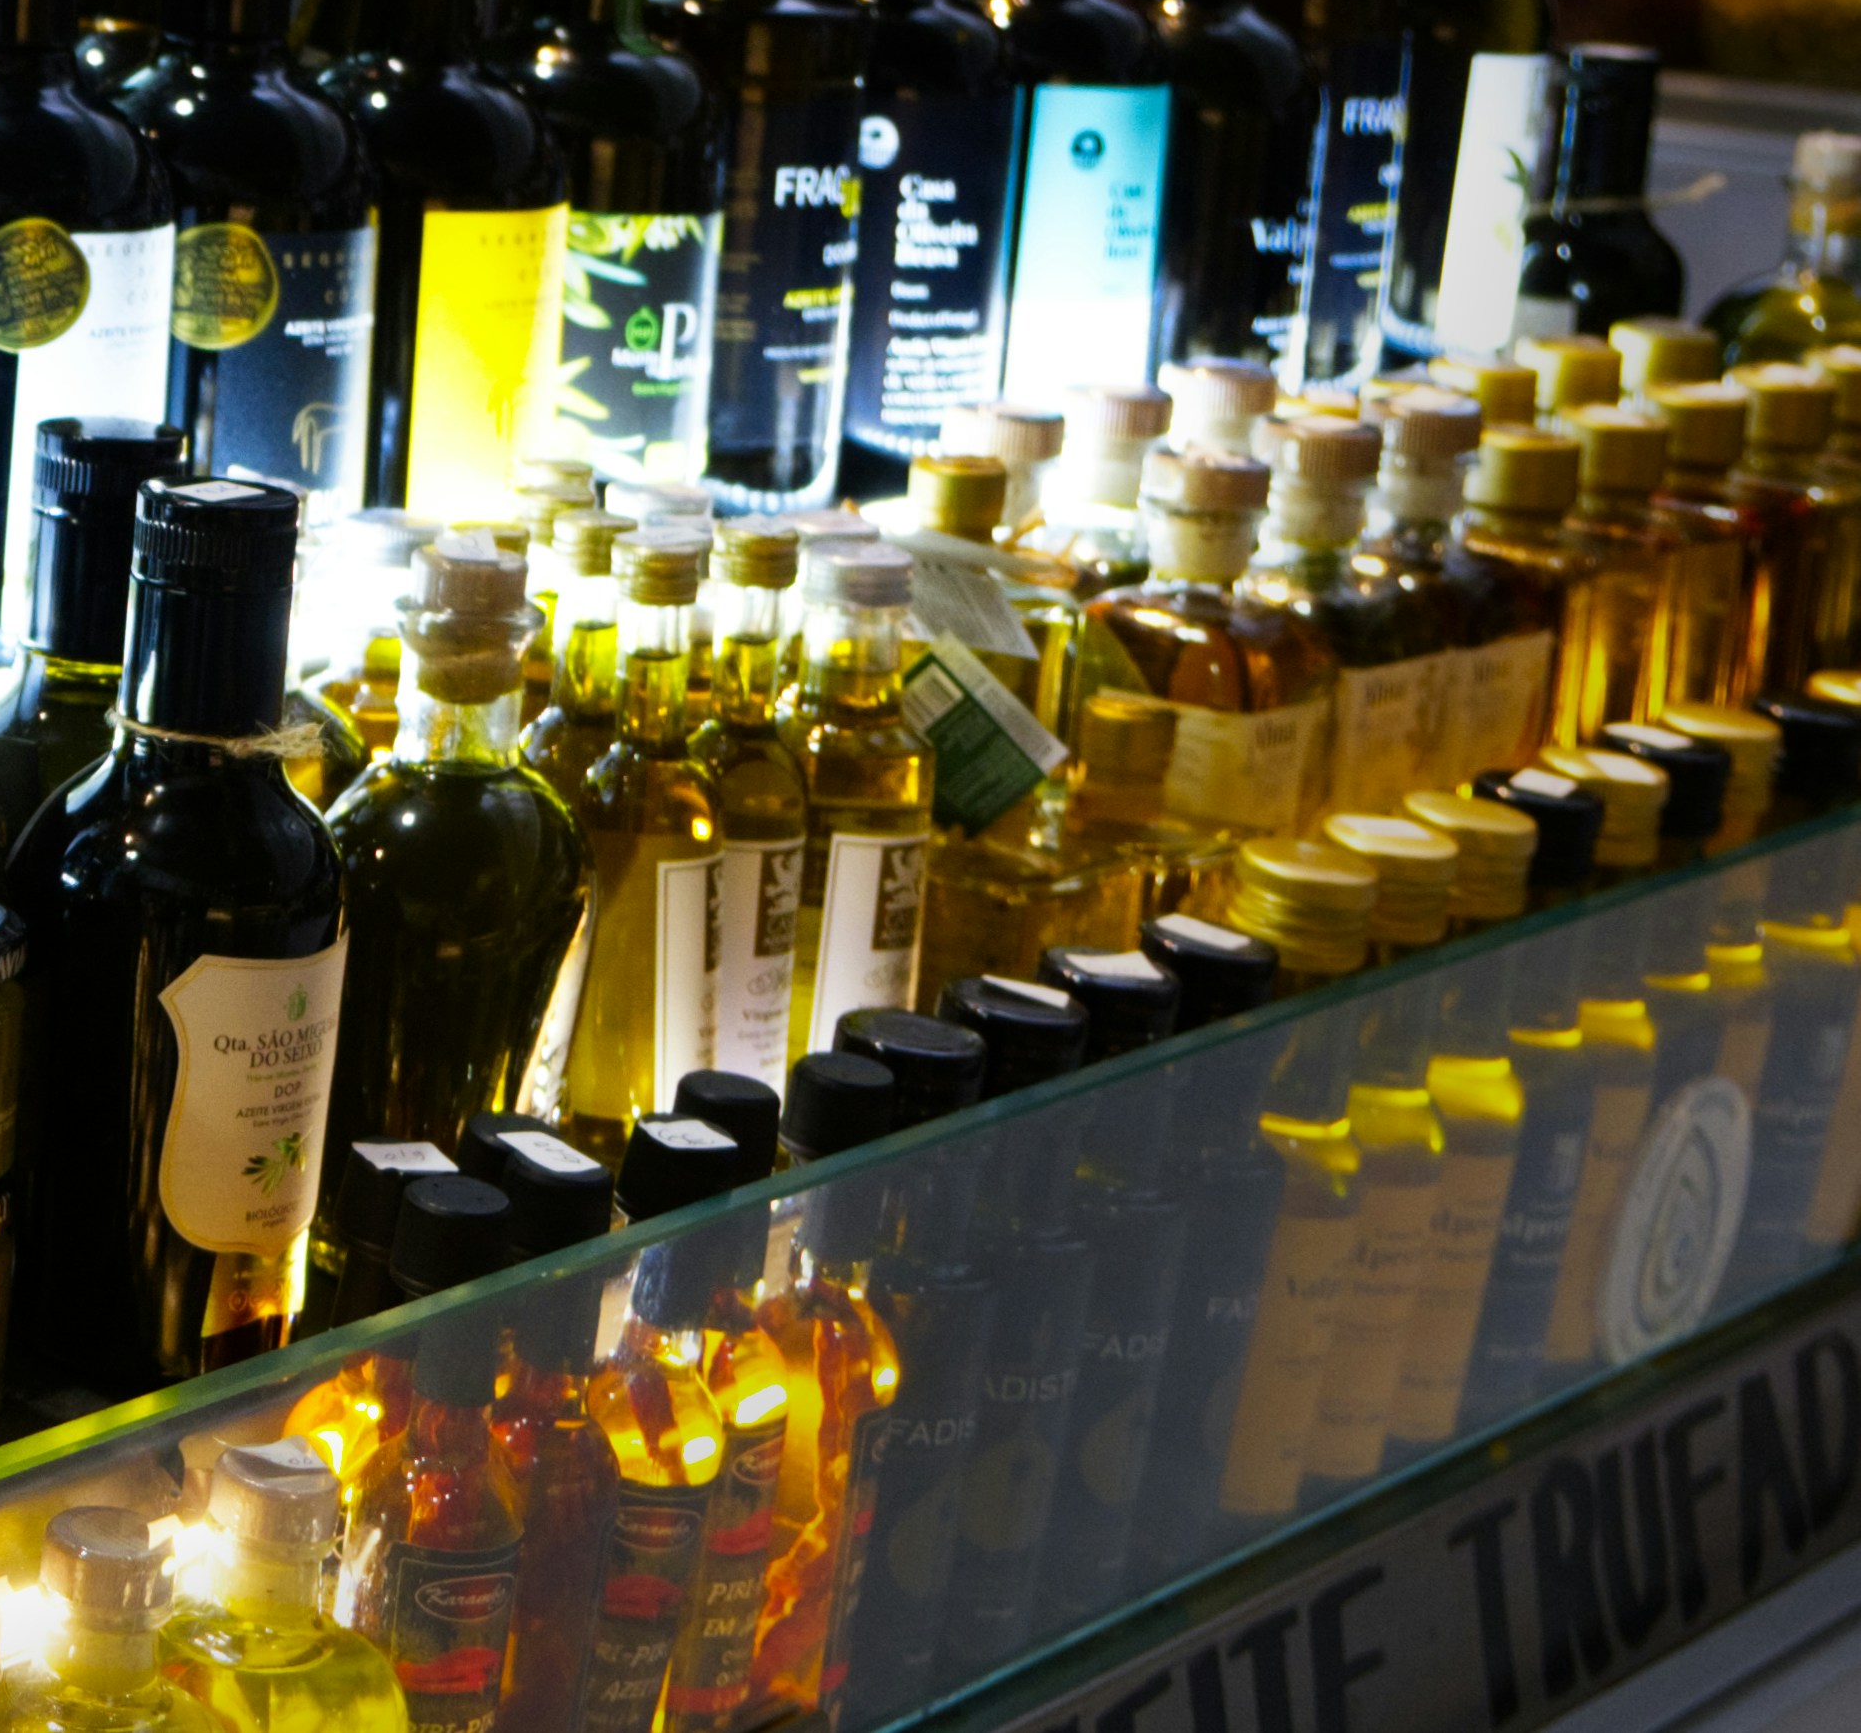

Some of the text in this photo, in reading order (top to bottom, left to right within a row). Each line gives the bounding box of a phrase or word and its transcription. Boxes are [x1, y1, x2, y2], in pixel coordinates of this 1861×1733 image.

[213, 1028, 292, 1054] Qta. SÃO
[249, 1038, 323, 1069] DO SEIXO
[273, 1080, 302, 1099] DOP
[235, 1100, 303, 1119] AZEITE VIRGEM
